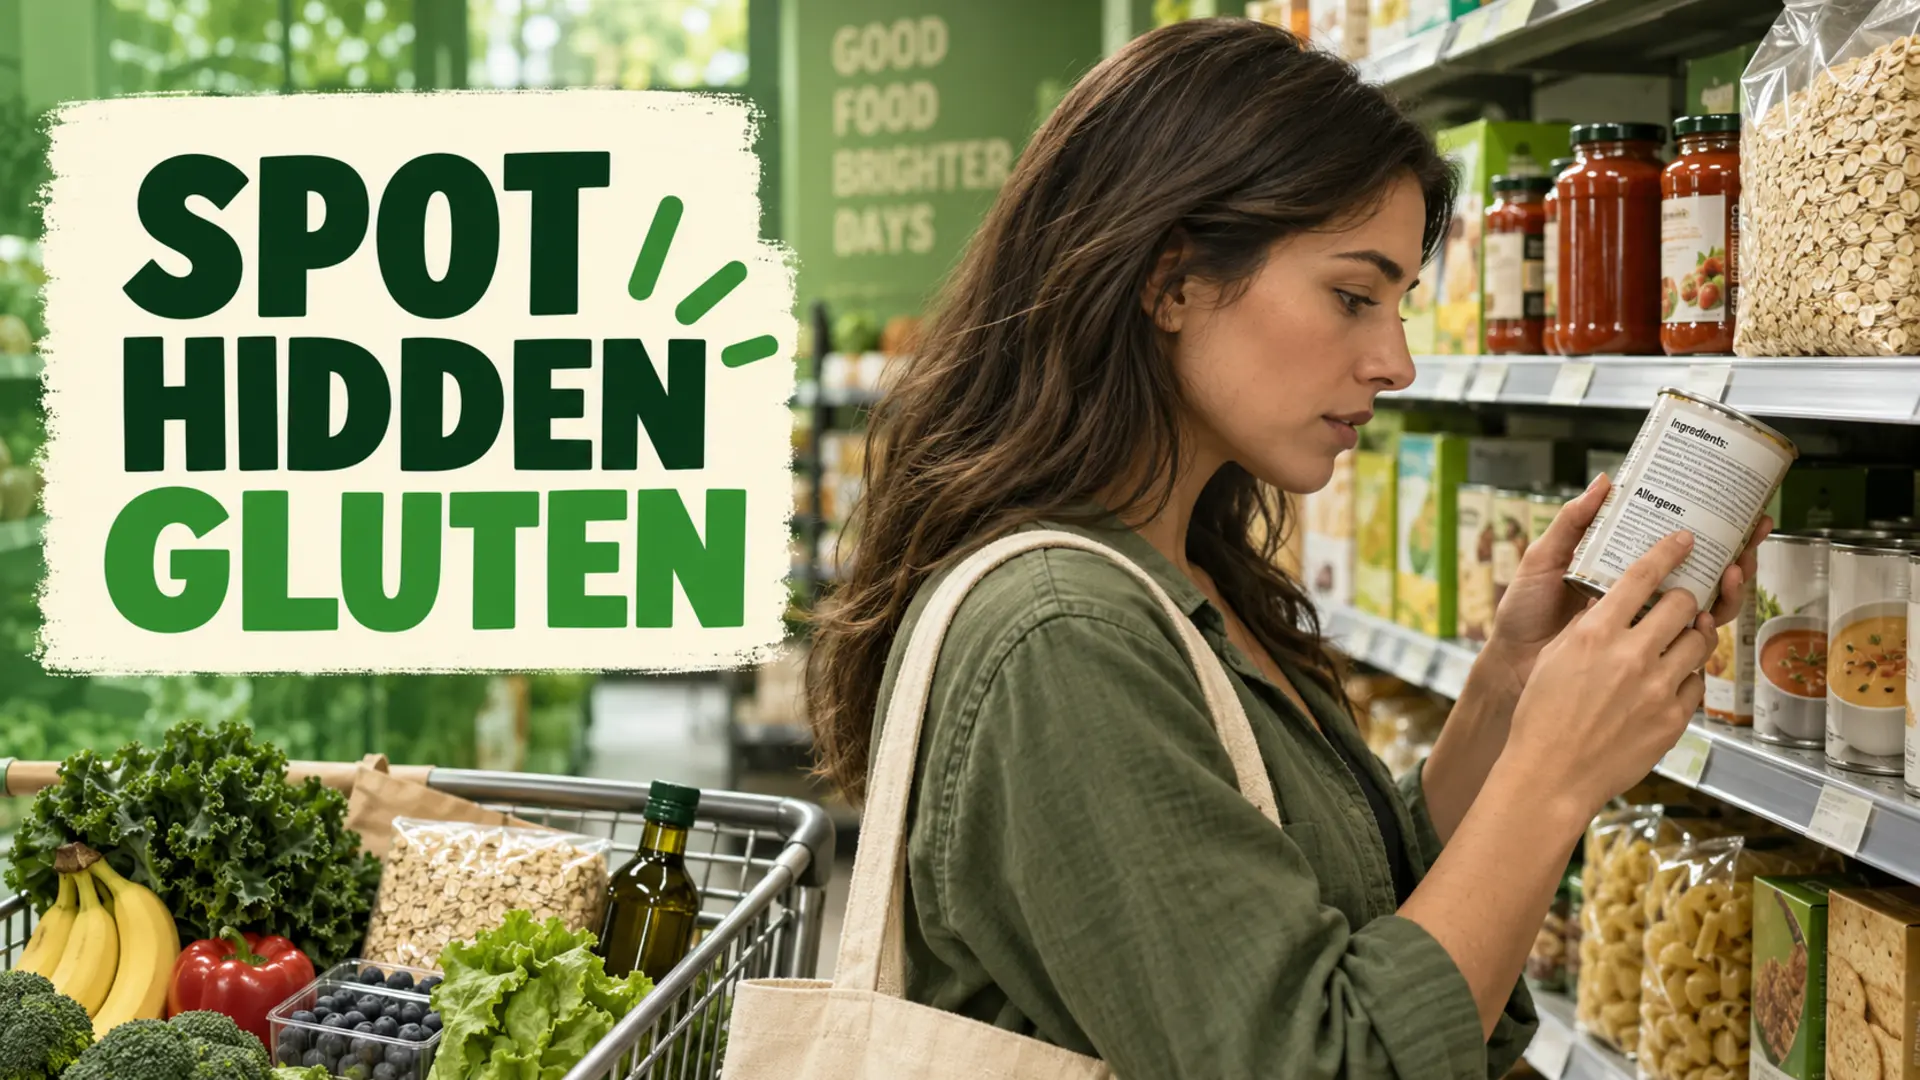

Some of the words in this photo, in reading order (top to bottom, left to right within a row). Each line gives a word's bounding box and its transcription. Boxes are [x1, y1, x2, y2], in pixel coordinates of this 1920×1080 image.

[831, 17, 948, 77] GOOD
[831, 81, 939, 137] FOOD
[831, 138, 1013, 197] BRIGHTER
[832, 204, 934, 257] DAYS
[1670, 417, 1729, 449] Ingredients:
[1634, 487, 1686, 517] Allergens:
